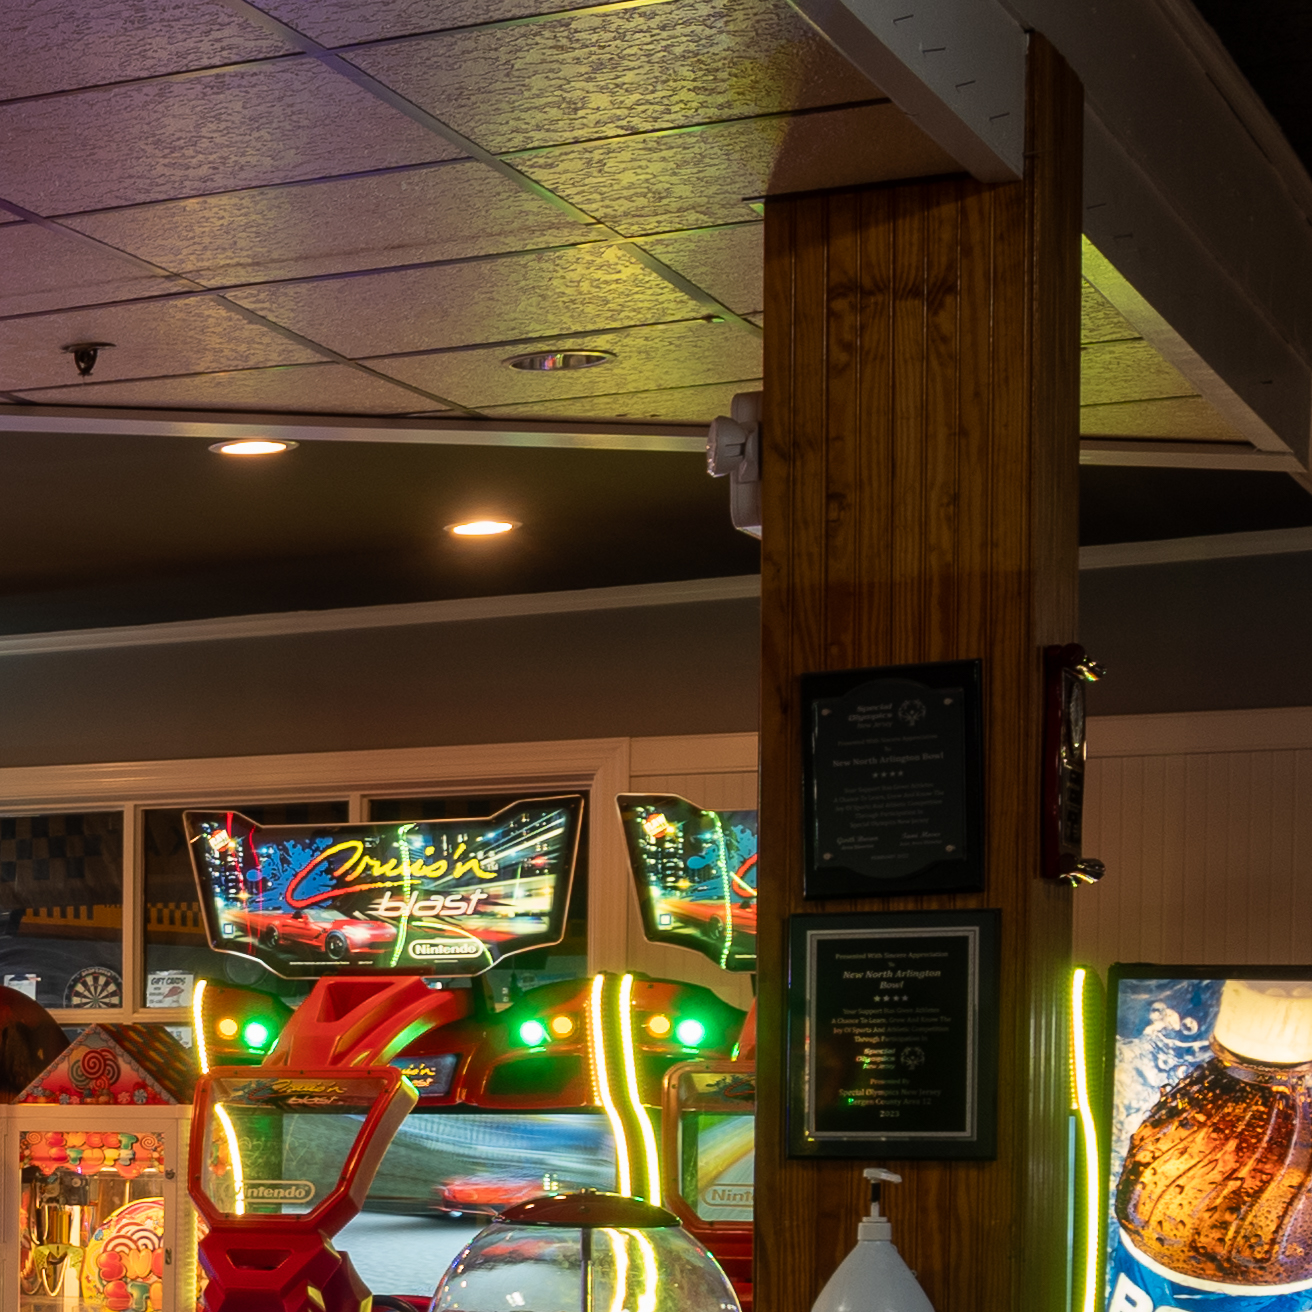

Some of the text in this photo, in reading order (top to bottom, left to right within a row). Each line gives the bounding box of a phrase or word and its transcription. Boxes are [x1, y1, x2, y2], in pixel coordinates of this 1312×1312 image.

[853, 757, 877, 766] North
[880, 754, 920, 765] Arlington
[922, 751, 944, 761] Bowl
[287, 840, 498, 909] Cruis'n
[368, 889, 488, 918] blast
[415, 942, 477, 957] Nintendo
[843, 969, 941, 980] New North Arlington
[879, 980, 905, 990] Bowl
[44, 1131, 138, 1150] SWEET
